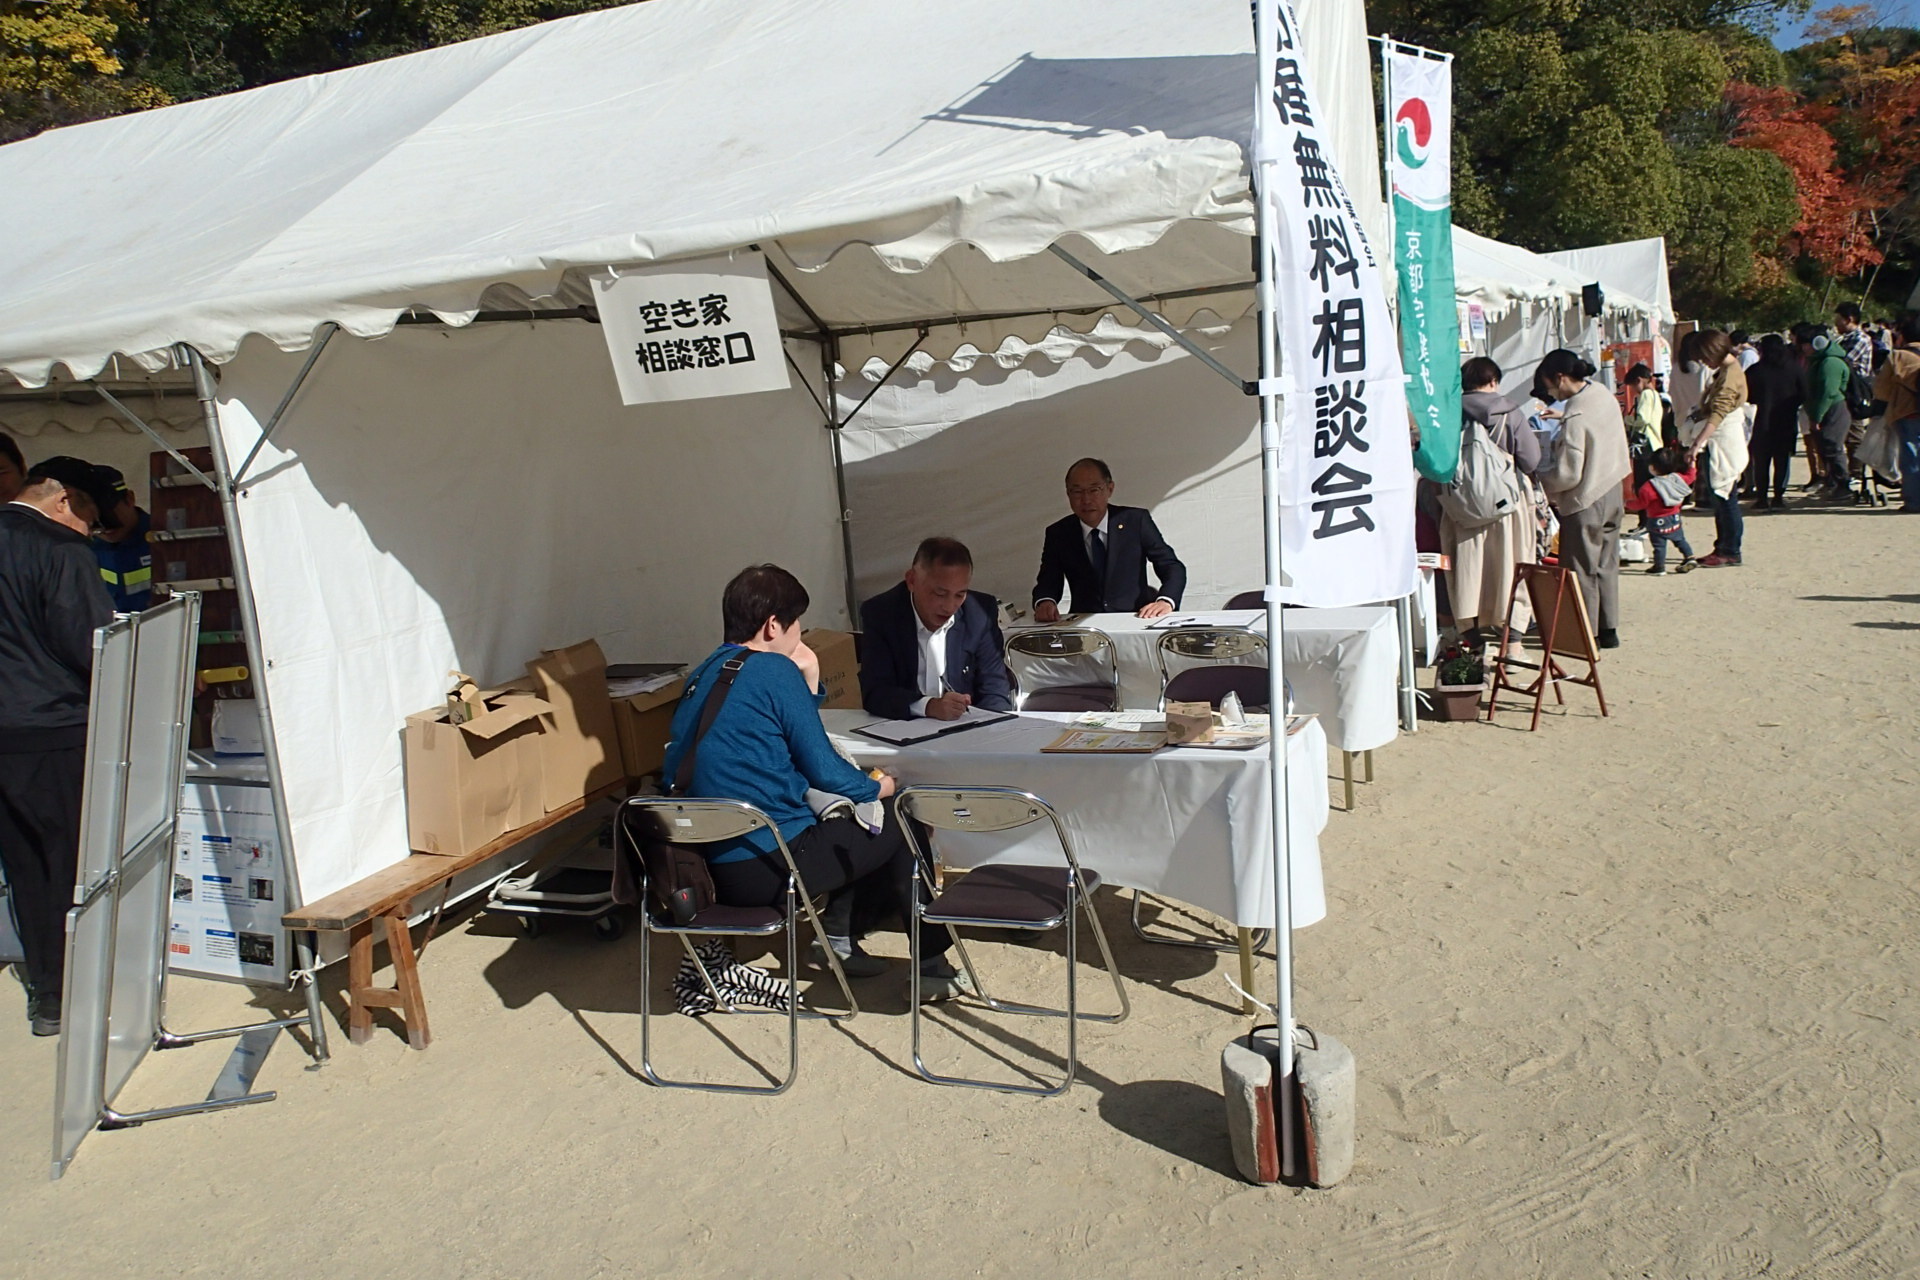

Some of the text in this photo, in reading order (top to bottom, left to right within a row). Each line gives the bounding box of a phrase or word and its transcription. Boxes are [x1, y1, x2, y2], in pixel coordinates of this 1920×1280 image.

[638, 293, 731, 334] 空き家
[635, 331, 755, 374] 相談窓口
